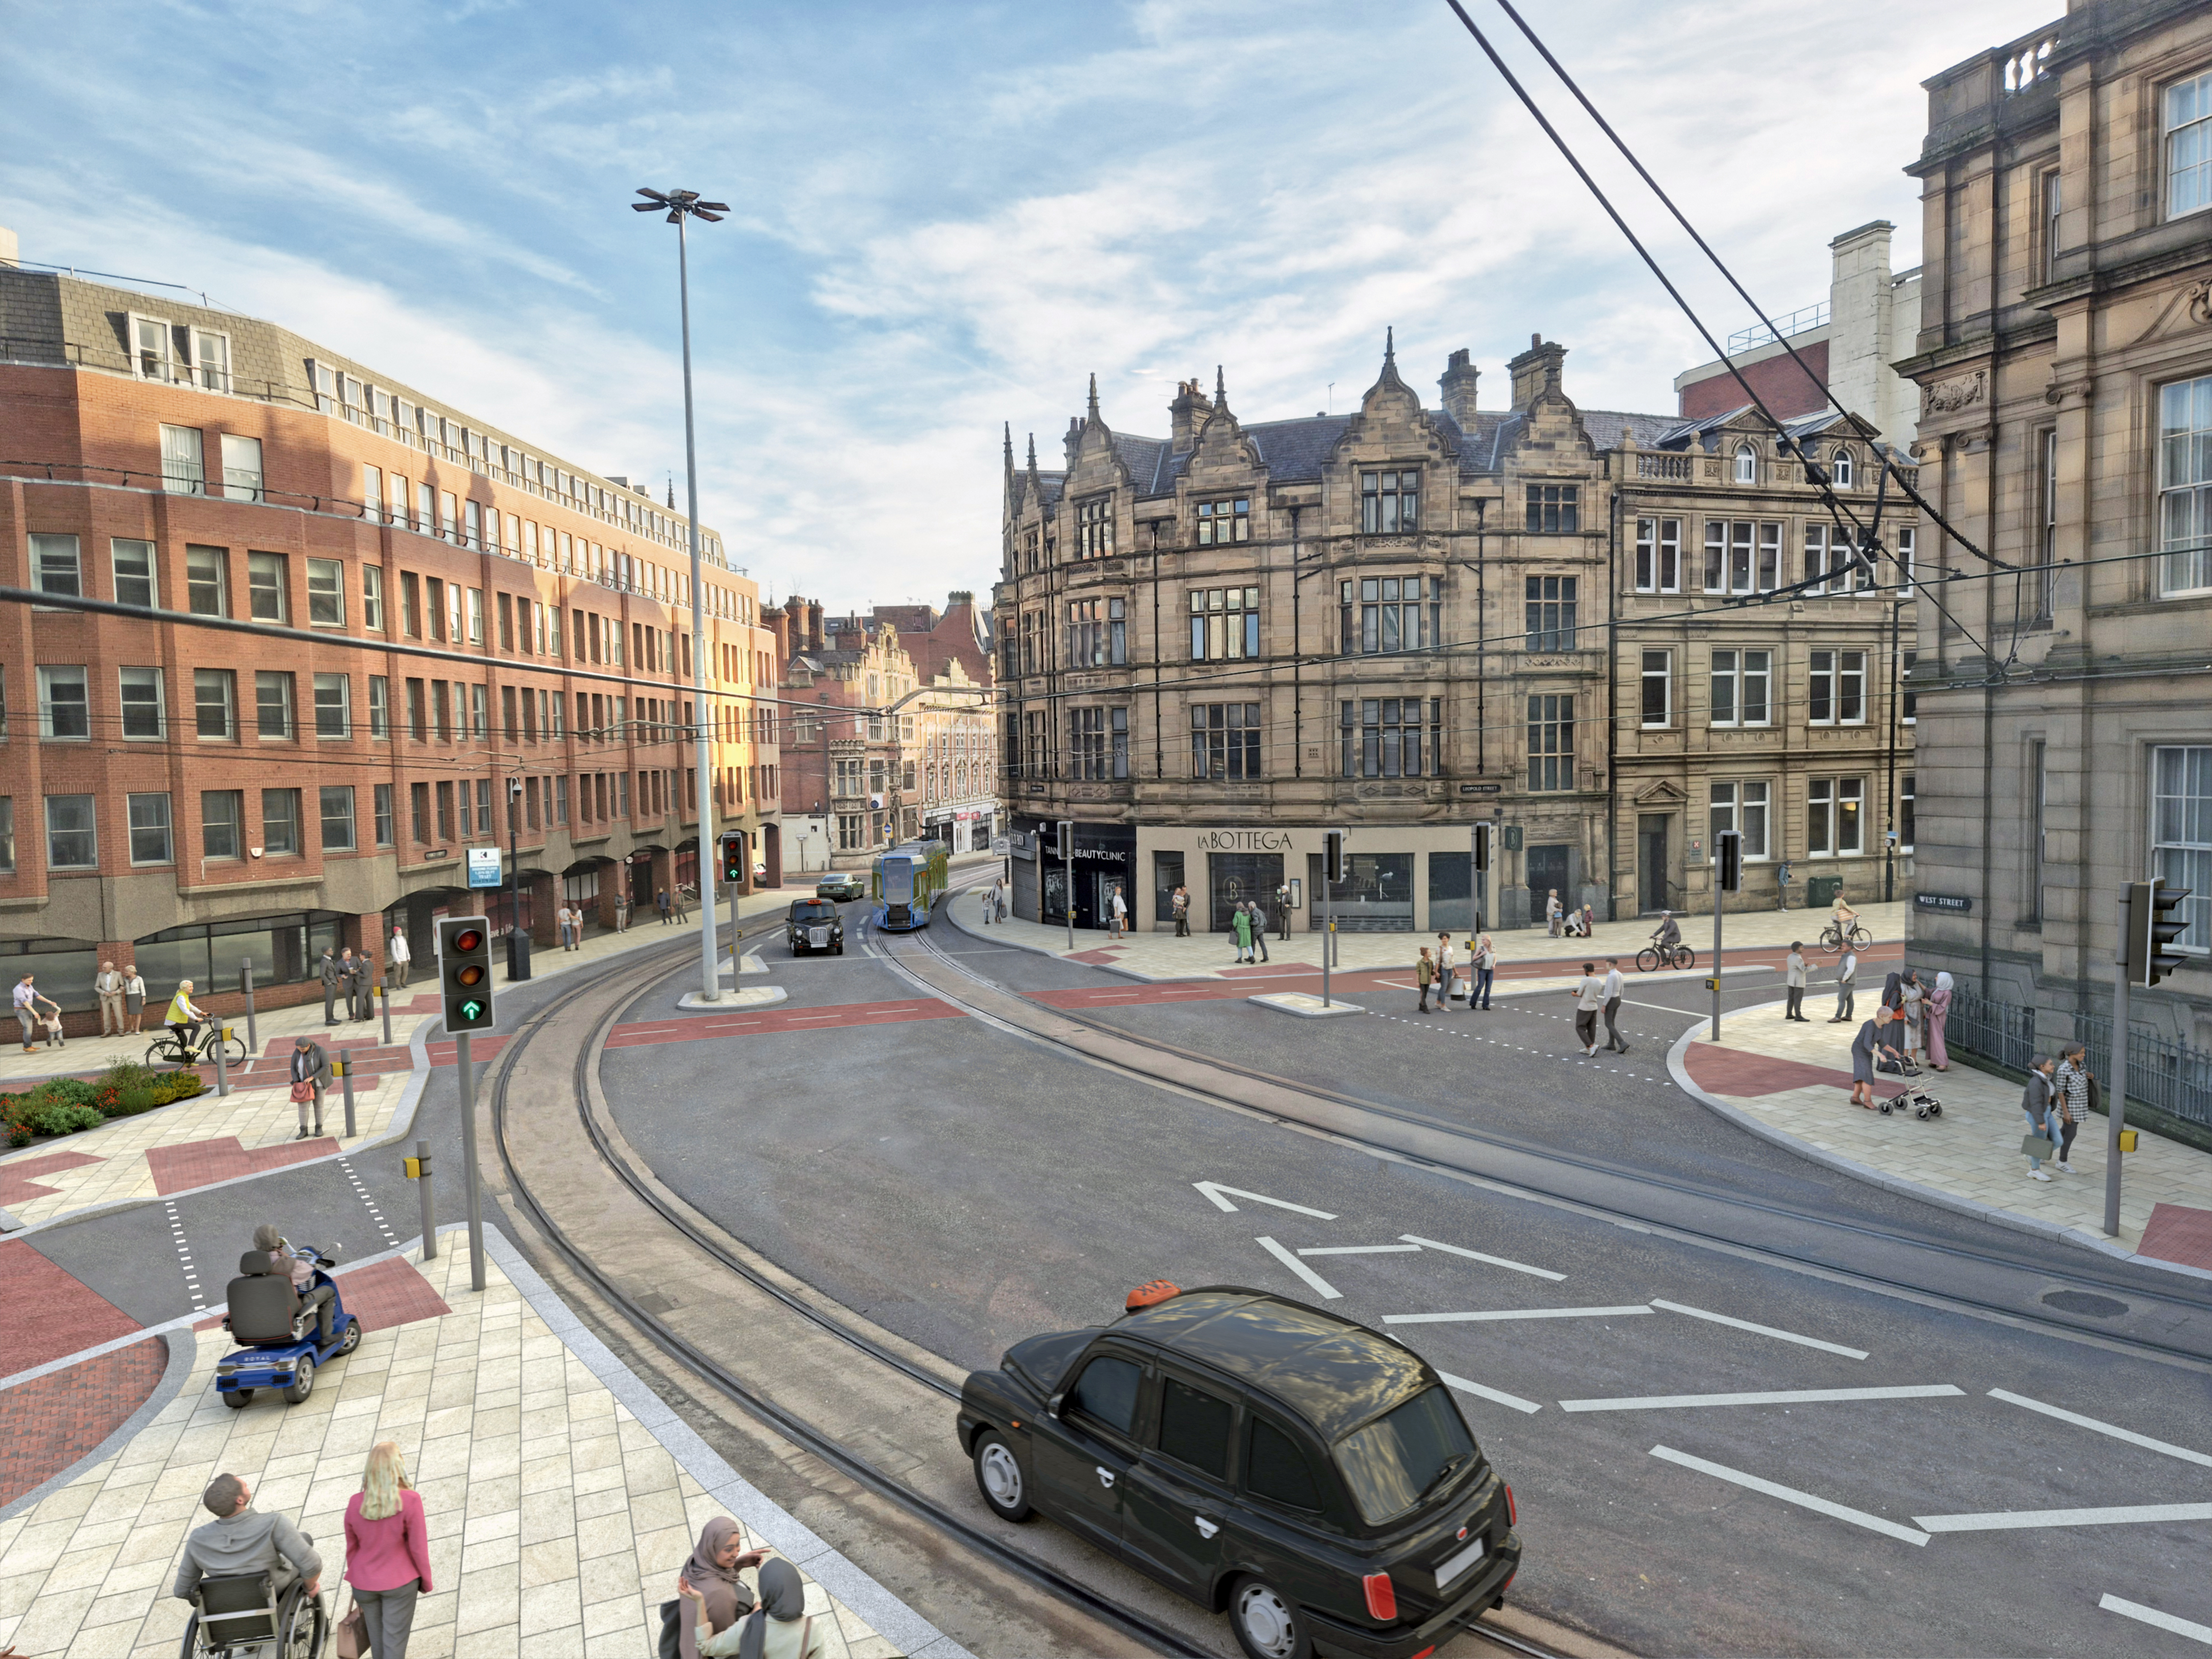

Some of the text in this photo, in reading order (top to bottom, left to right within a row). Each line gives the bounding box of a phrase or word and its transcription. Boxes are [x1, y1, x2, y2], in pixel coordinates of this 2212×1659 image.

[1197, 831, 1293, 849] LA BOTTEGA
[1229, 881, 1238, 900] B
[1919, 896, 1964, 907] WEST STREET
[490, 929, 499, 938] ave
[505, 924, 514, 933] life
